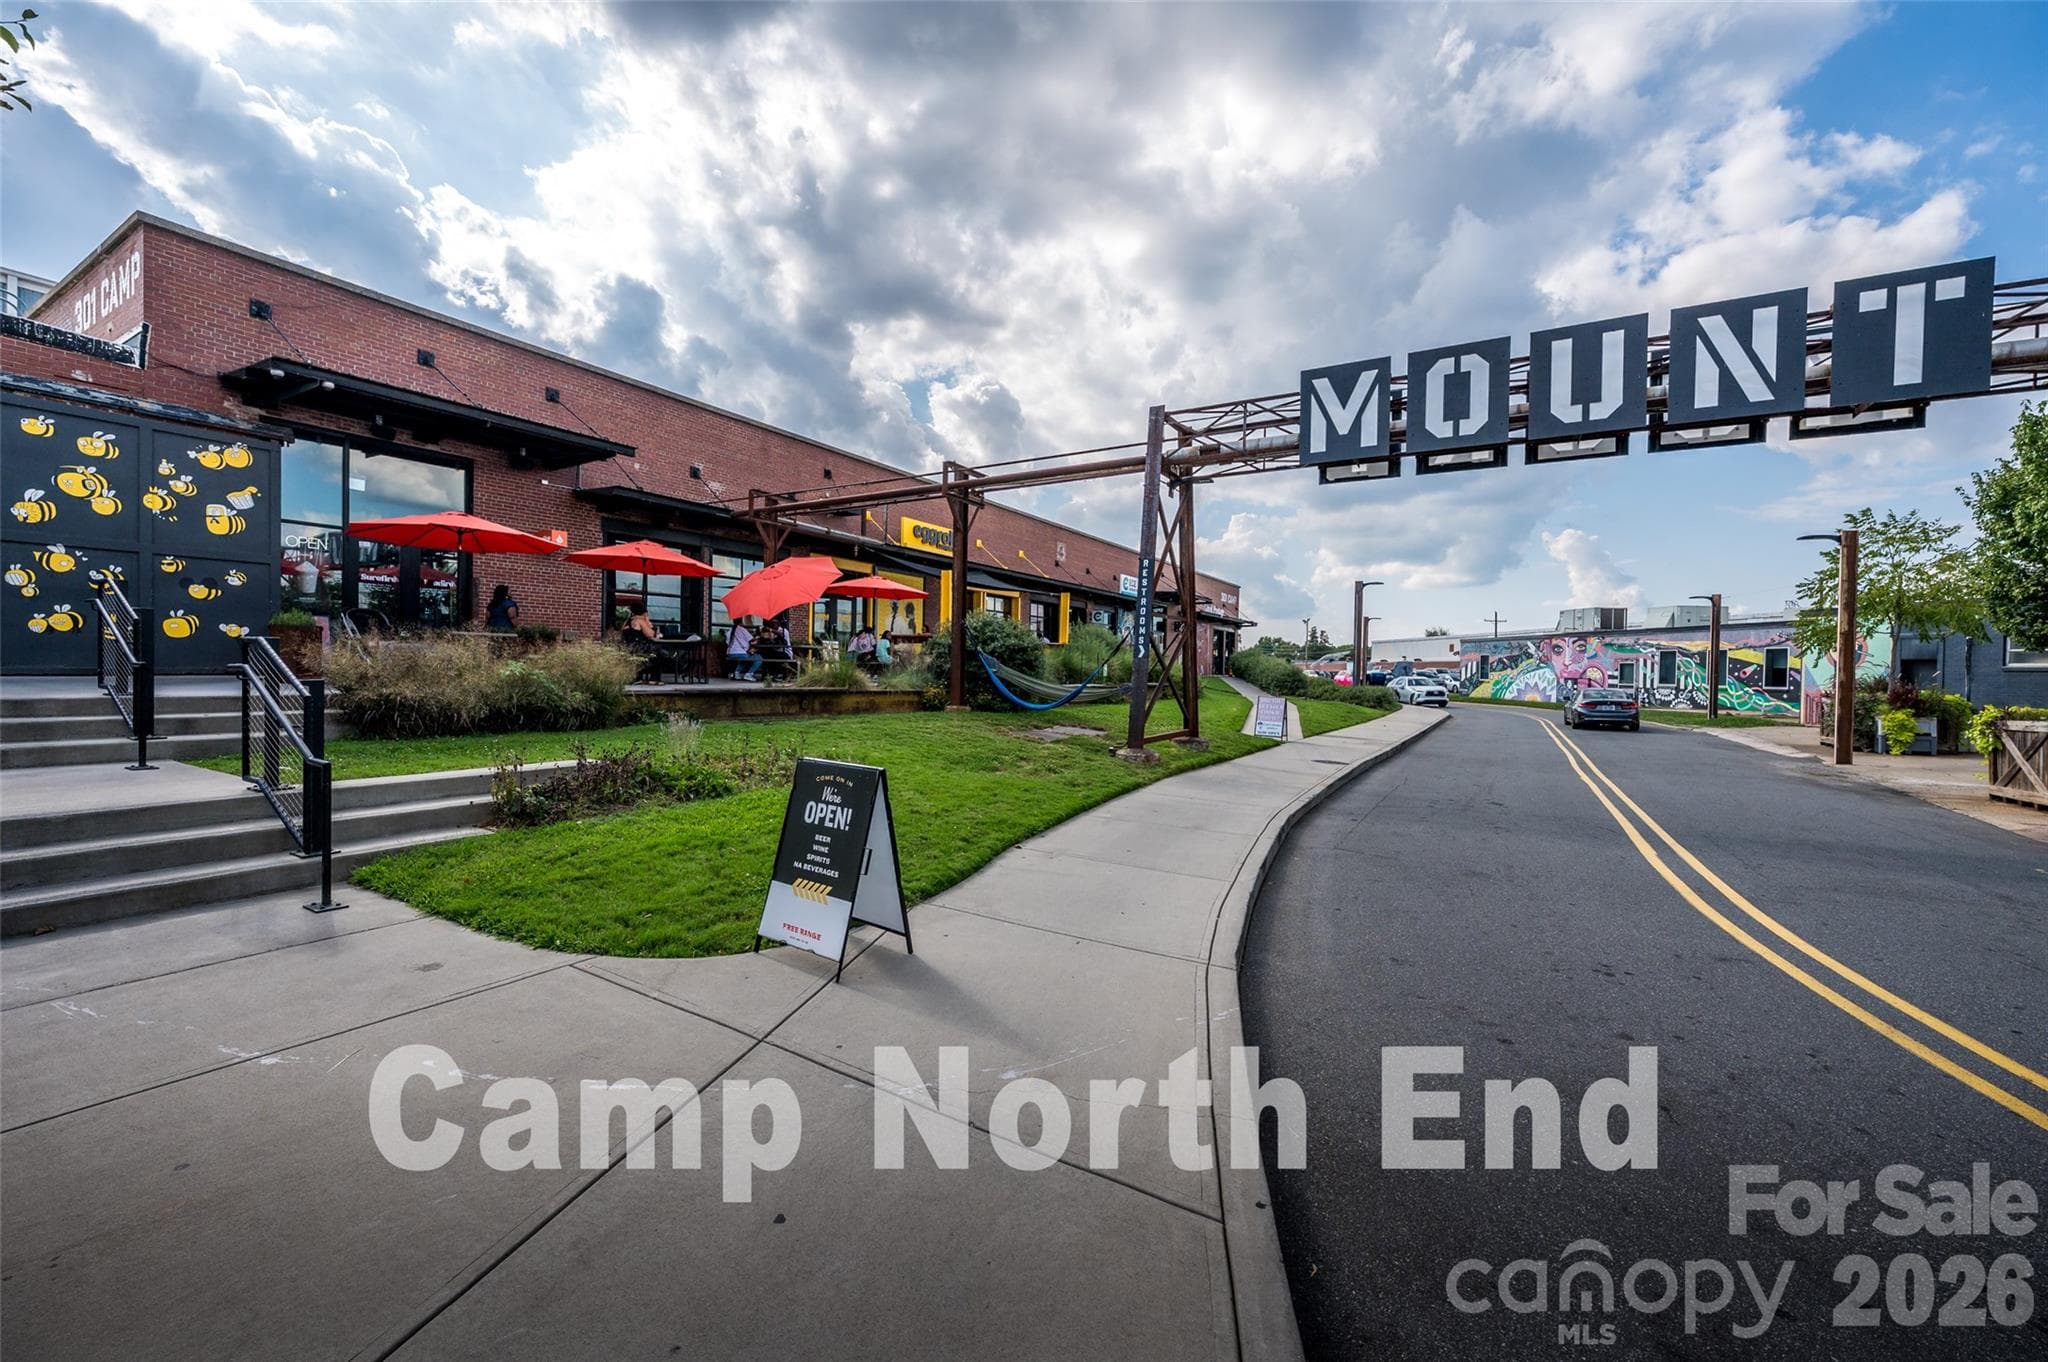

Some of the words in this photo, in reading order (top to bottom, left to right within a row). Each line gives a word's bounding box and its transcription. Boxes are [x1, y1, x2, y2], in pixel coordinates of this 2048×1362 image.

[74, 287, 97, 334] 301
[101, 251, 140, 318] CAMP
[1310, 276, 1966, 454] MOUNT
[285, 535, 329, 551] OPEN
[912, 525, 953, 546] eggrol
[1138, 559, 1149, 645] RESTROOMS
[804, 800, 853, 831] OPEN!
[815, 834, 831, 843] BEER
[812, 844, 829, 853] WINE
[806, 853, 830, 865] SPIRITS
[793, 861, 802, 869] NA
[803, 863, 839, 878] BEVERAGES
[783, 922, 799, 933] FREE
[800, 928, 822, 941] RANGE
